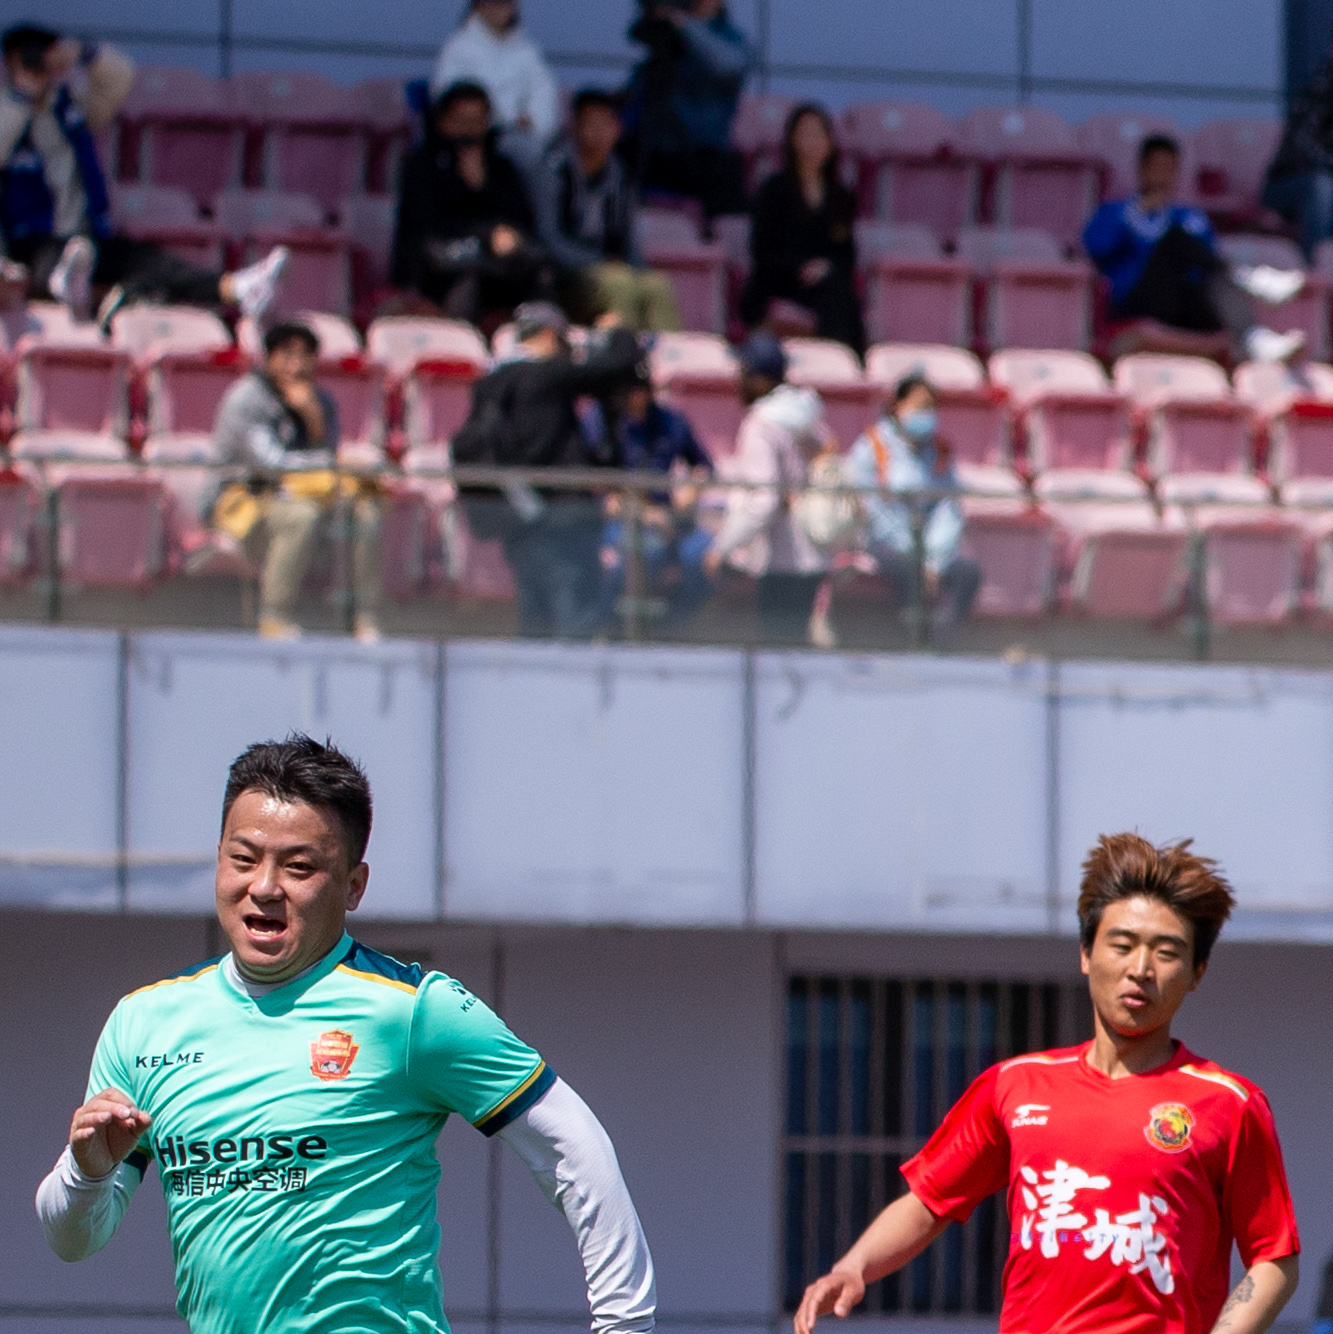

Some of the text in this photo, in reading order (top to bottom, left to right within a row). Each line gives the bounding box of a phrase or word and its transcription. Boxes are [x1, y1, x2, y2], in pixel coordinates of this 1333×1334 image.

[135, 1052, 204, 1068] KELME
[155, 1136, 328, 1168] Hisense
[170, 1166, 308, 1196] 海信中央空调
[1020, 1159, 1176, 1294] 津城
